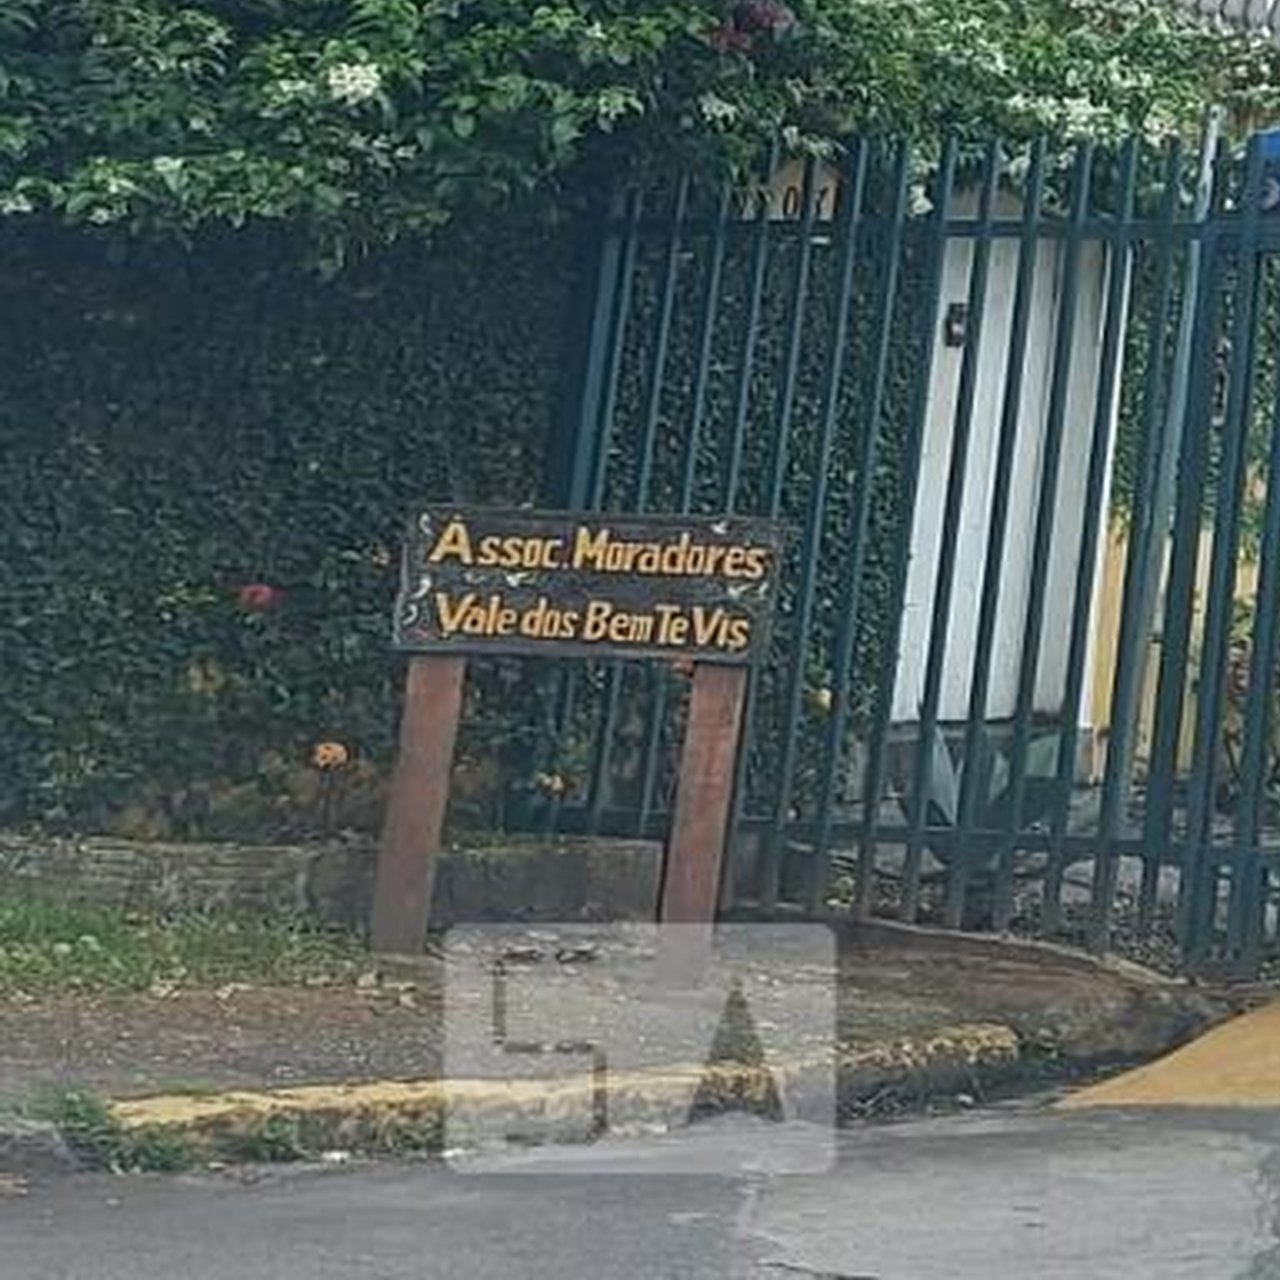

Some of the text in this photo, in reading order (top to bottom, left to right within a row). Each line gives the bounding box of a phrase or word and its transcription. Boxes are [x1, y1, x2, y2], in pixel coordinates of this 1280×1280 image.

[428, 515, 767, 579] Assoc. Moradores
[435, 591, 518, 639] Vale
[583, 600, 653, 642] Bem
[655, 603, 689, 645] Te
[692, 606, 750, 649] Vis
